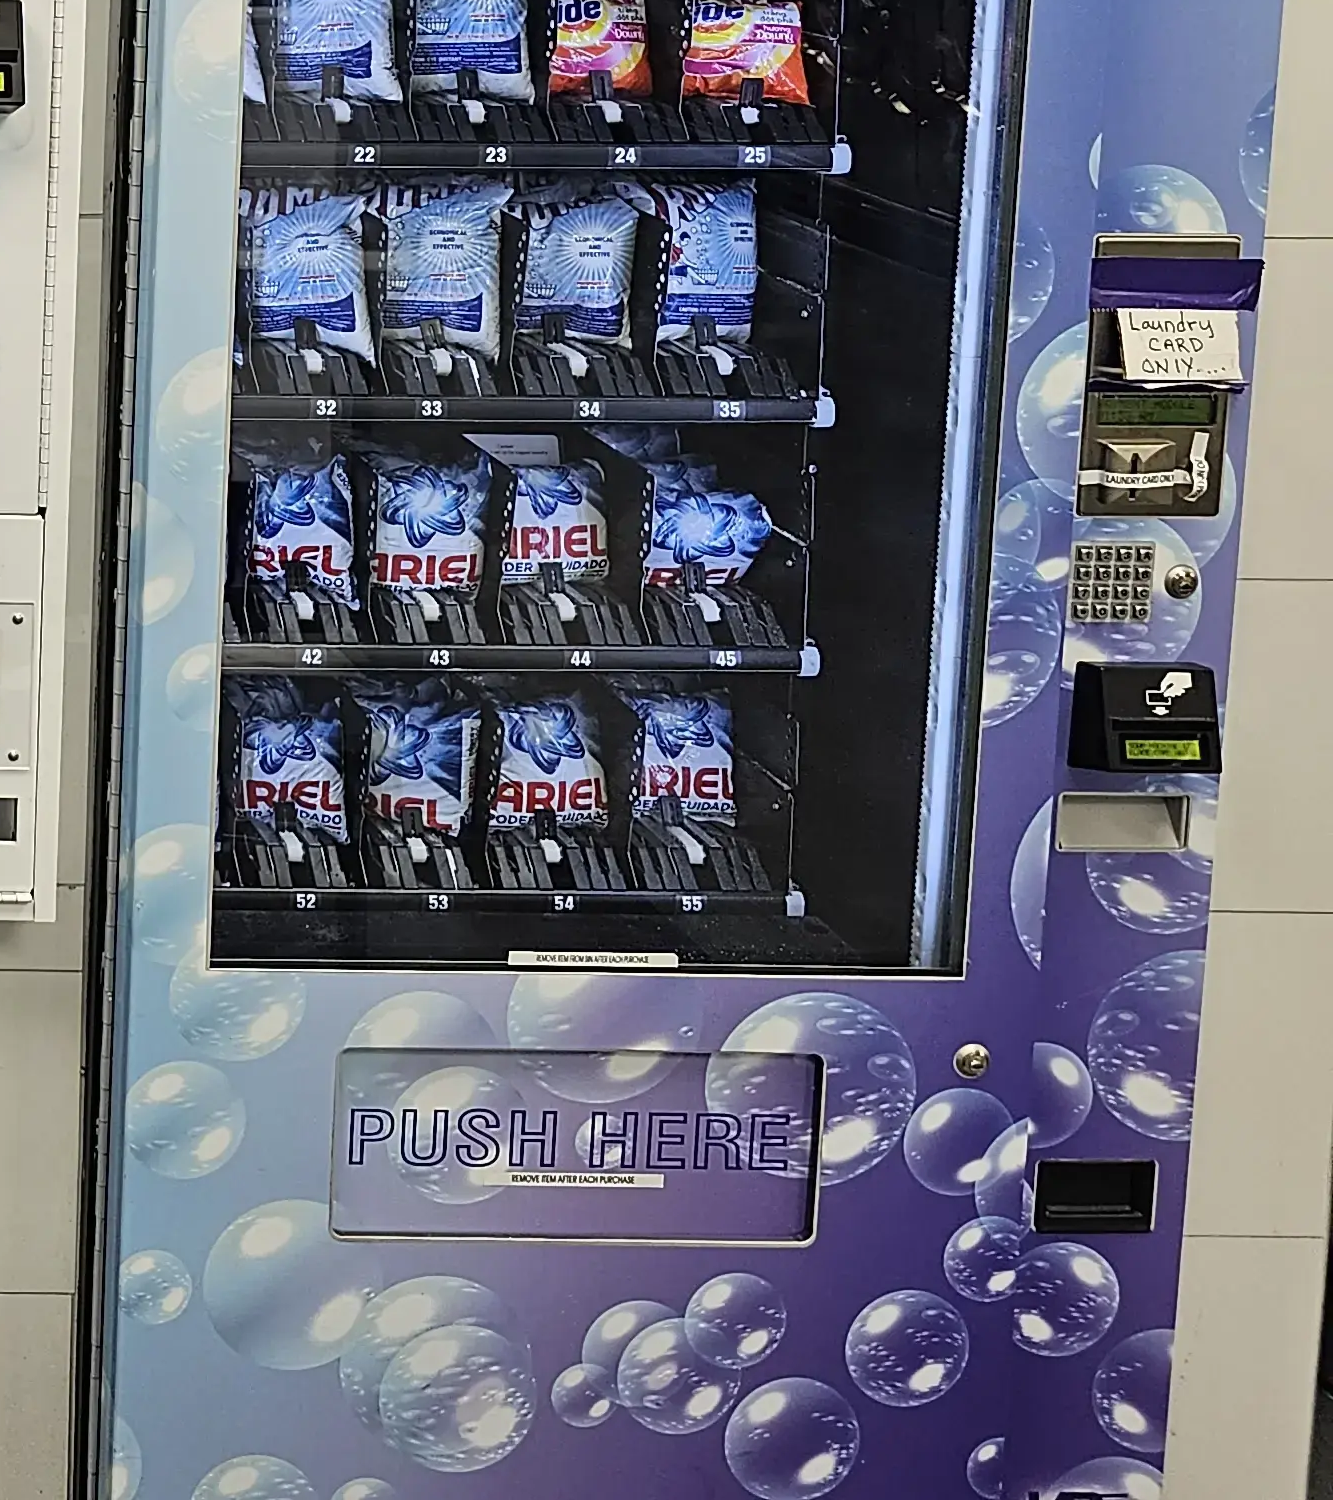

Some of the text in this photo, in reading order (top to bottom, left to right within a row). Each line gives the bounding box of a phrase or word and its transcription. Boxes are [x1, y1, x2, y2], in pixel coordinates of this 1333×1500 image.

[353, 146, 376, 163] 22
[485, 146, 507, 163] 23
[614, 147, 637, 164] 24
[744, 146, 766, 164] 25
[1128, 311, 1215, 338] Laundry
[1149, 338, 1203, 353] CARD
[490, 777, 608, 813] ARIEL
[296, 893, 316, 909] 52
[428, 894, 449, 910] 53
[553, 895, 575, 911] 54
[681, 895, 703, 912] 55
[347, 1108, 790, 1172] PUSH HERE
